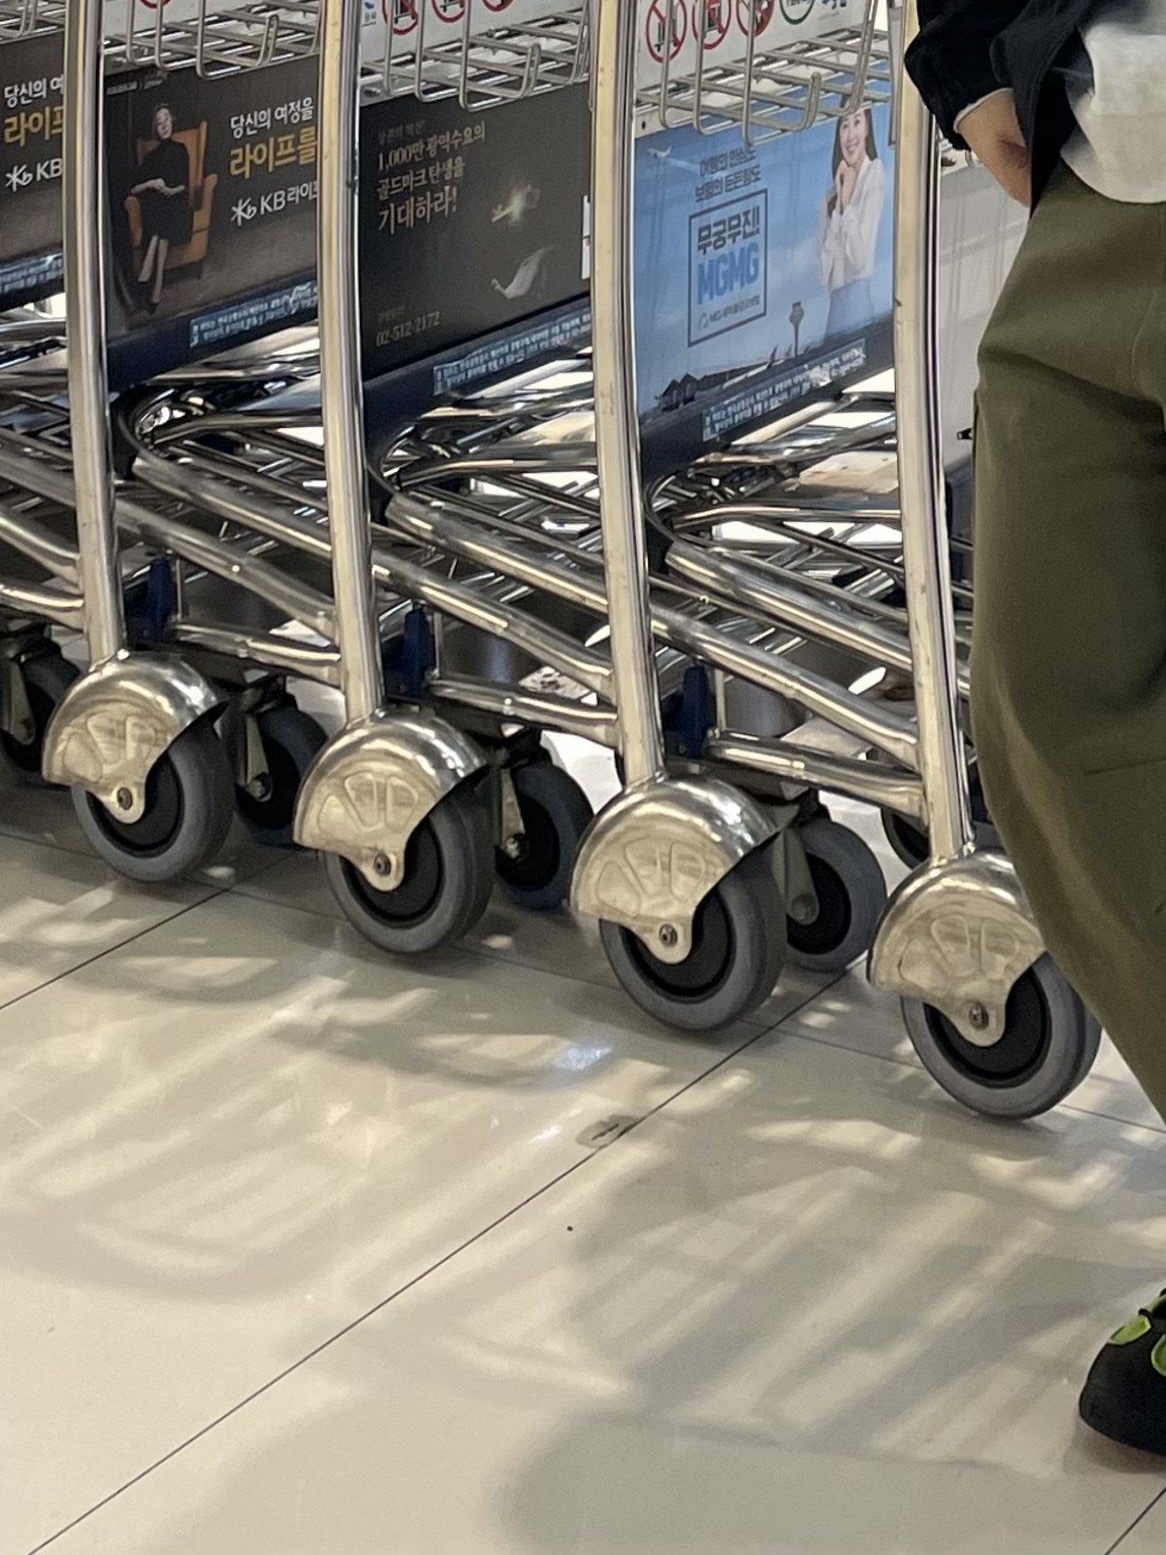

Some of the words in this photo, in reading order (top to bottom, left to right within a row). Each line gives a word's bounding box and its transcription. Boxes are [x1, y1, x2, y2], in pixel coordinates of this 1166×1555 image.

[4, 77, 47, 108] 당신의
[230, 106, 271, 139] 당신의
[274, 97, 314, 125] 여정을
[230, 126, 318, 180] 라이프를
[378, 185, 458, 235] 기대하라!
[697, 205, 760, 256] 무궁무진!
[697, 242, 760, 305] MGMG
